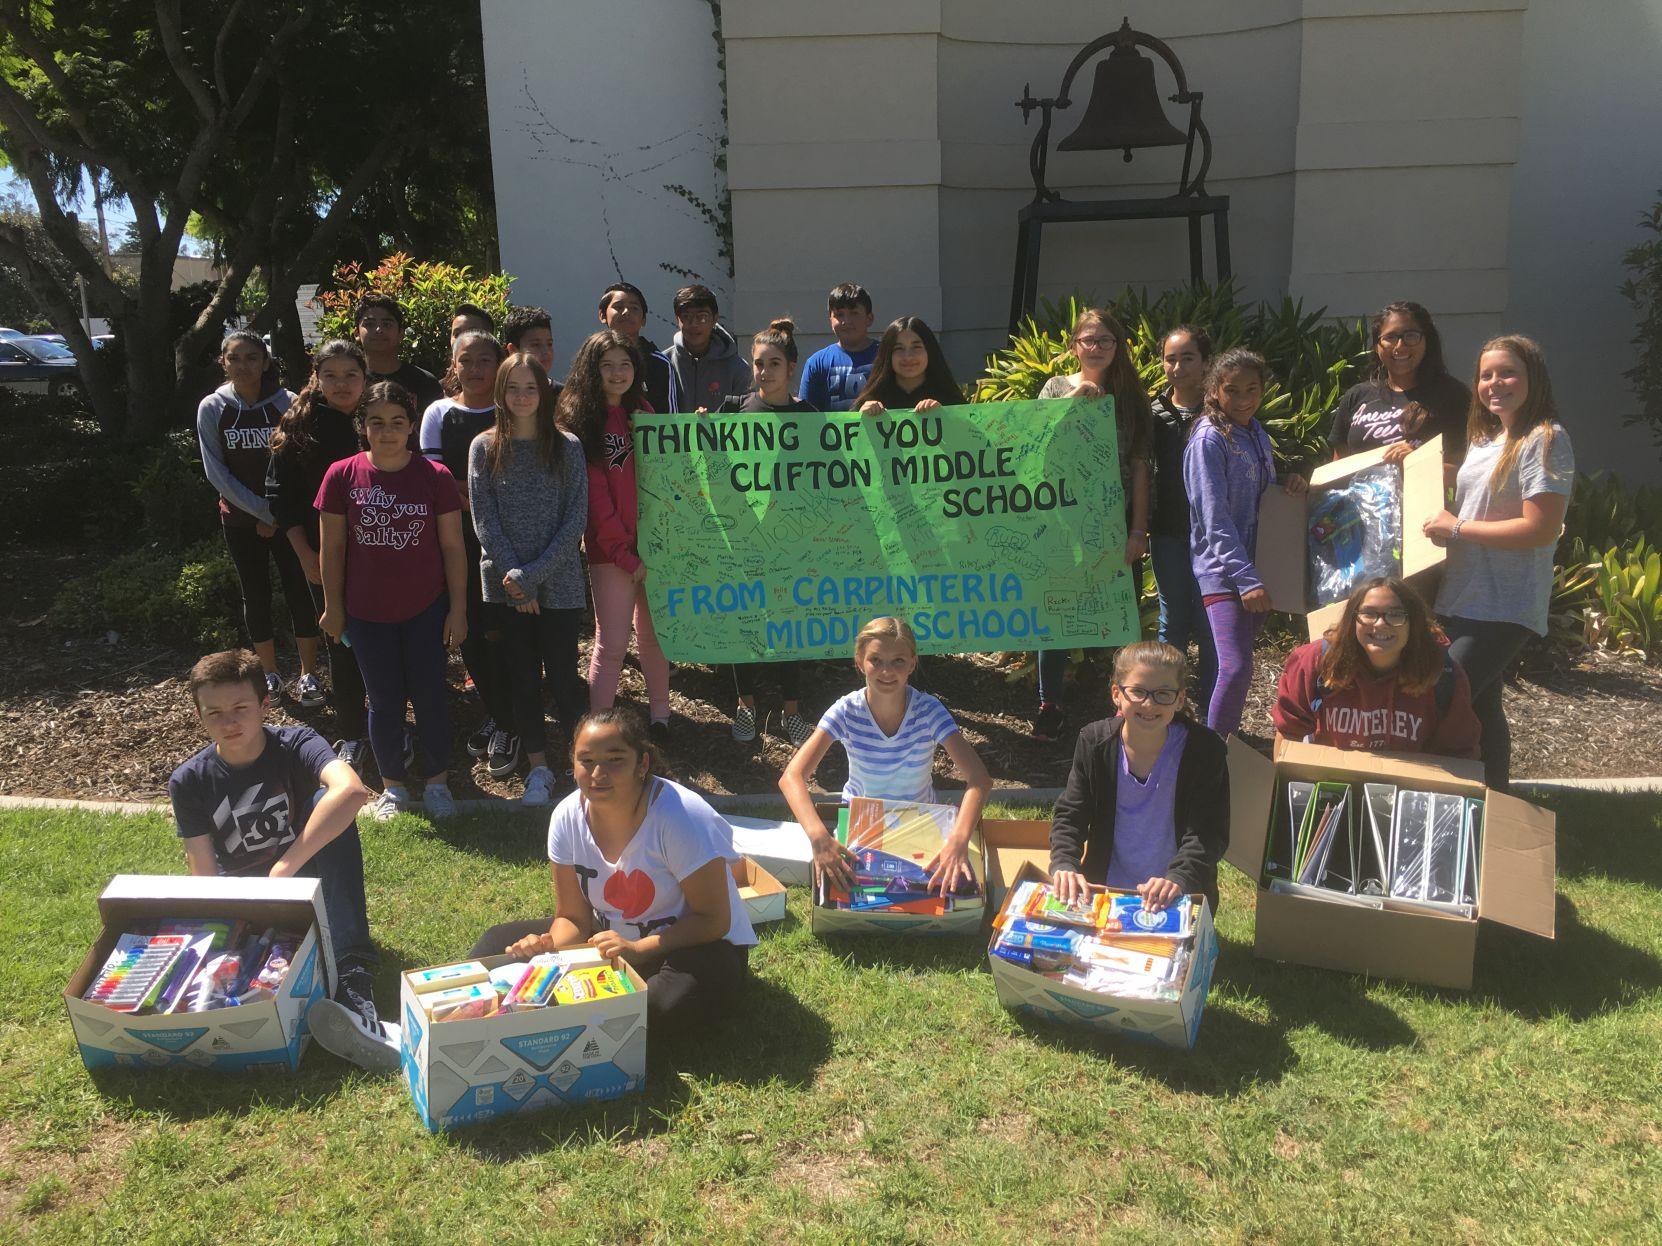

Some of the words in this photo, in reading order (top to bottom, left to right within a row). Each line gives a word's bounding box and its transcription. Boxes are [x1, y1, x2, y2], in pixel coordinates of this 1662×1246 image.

[635, 421, 800, 454] THINKING
[820, 421, 861, 451] OF
[876, 417, 943, 449] YOU
[730, 459, 871, 492] CLIFTON
[891, 447, 1016, 485] MIDDLE
[350, 485, 396, 508] Why
[392, 504, 427, 518] you
[942, 478, 1078, 518] SCHOOL
[361, 507, 390, 526] So
[667, 580, 765, 617] FROM
[793, 573, 1023, 606] CARPINTERIA
[767, 613, 892, 650] MIDDL
[912, 607, 1050, 641] SCHOOL
[518, 1036, 560, 1048] STANDARD
[561, 1033, 571, 1041] 92
